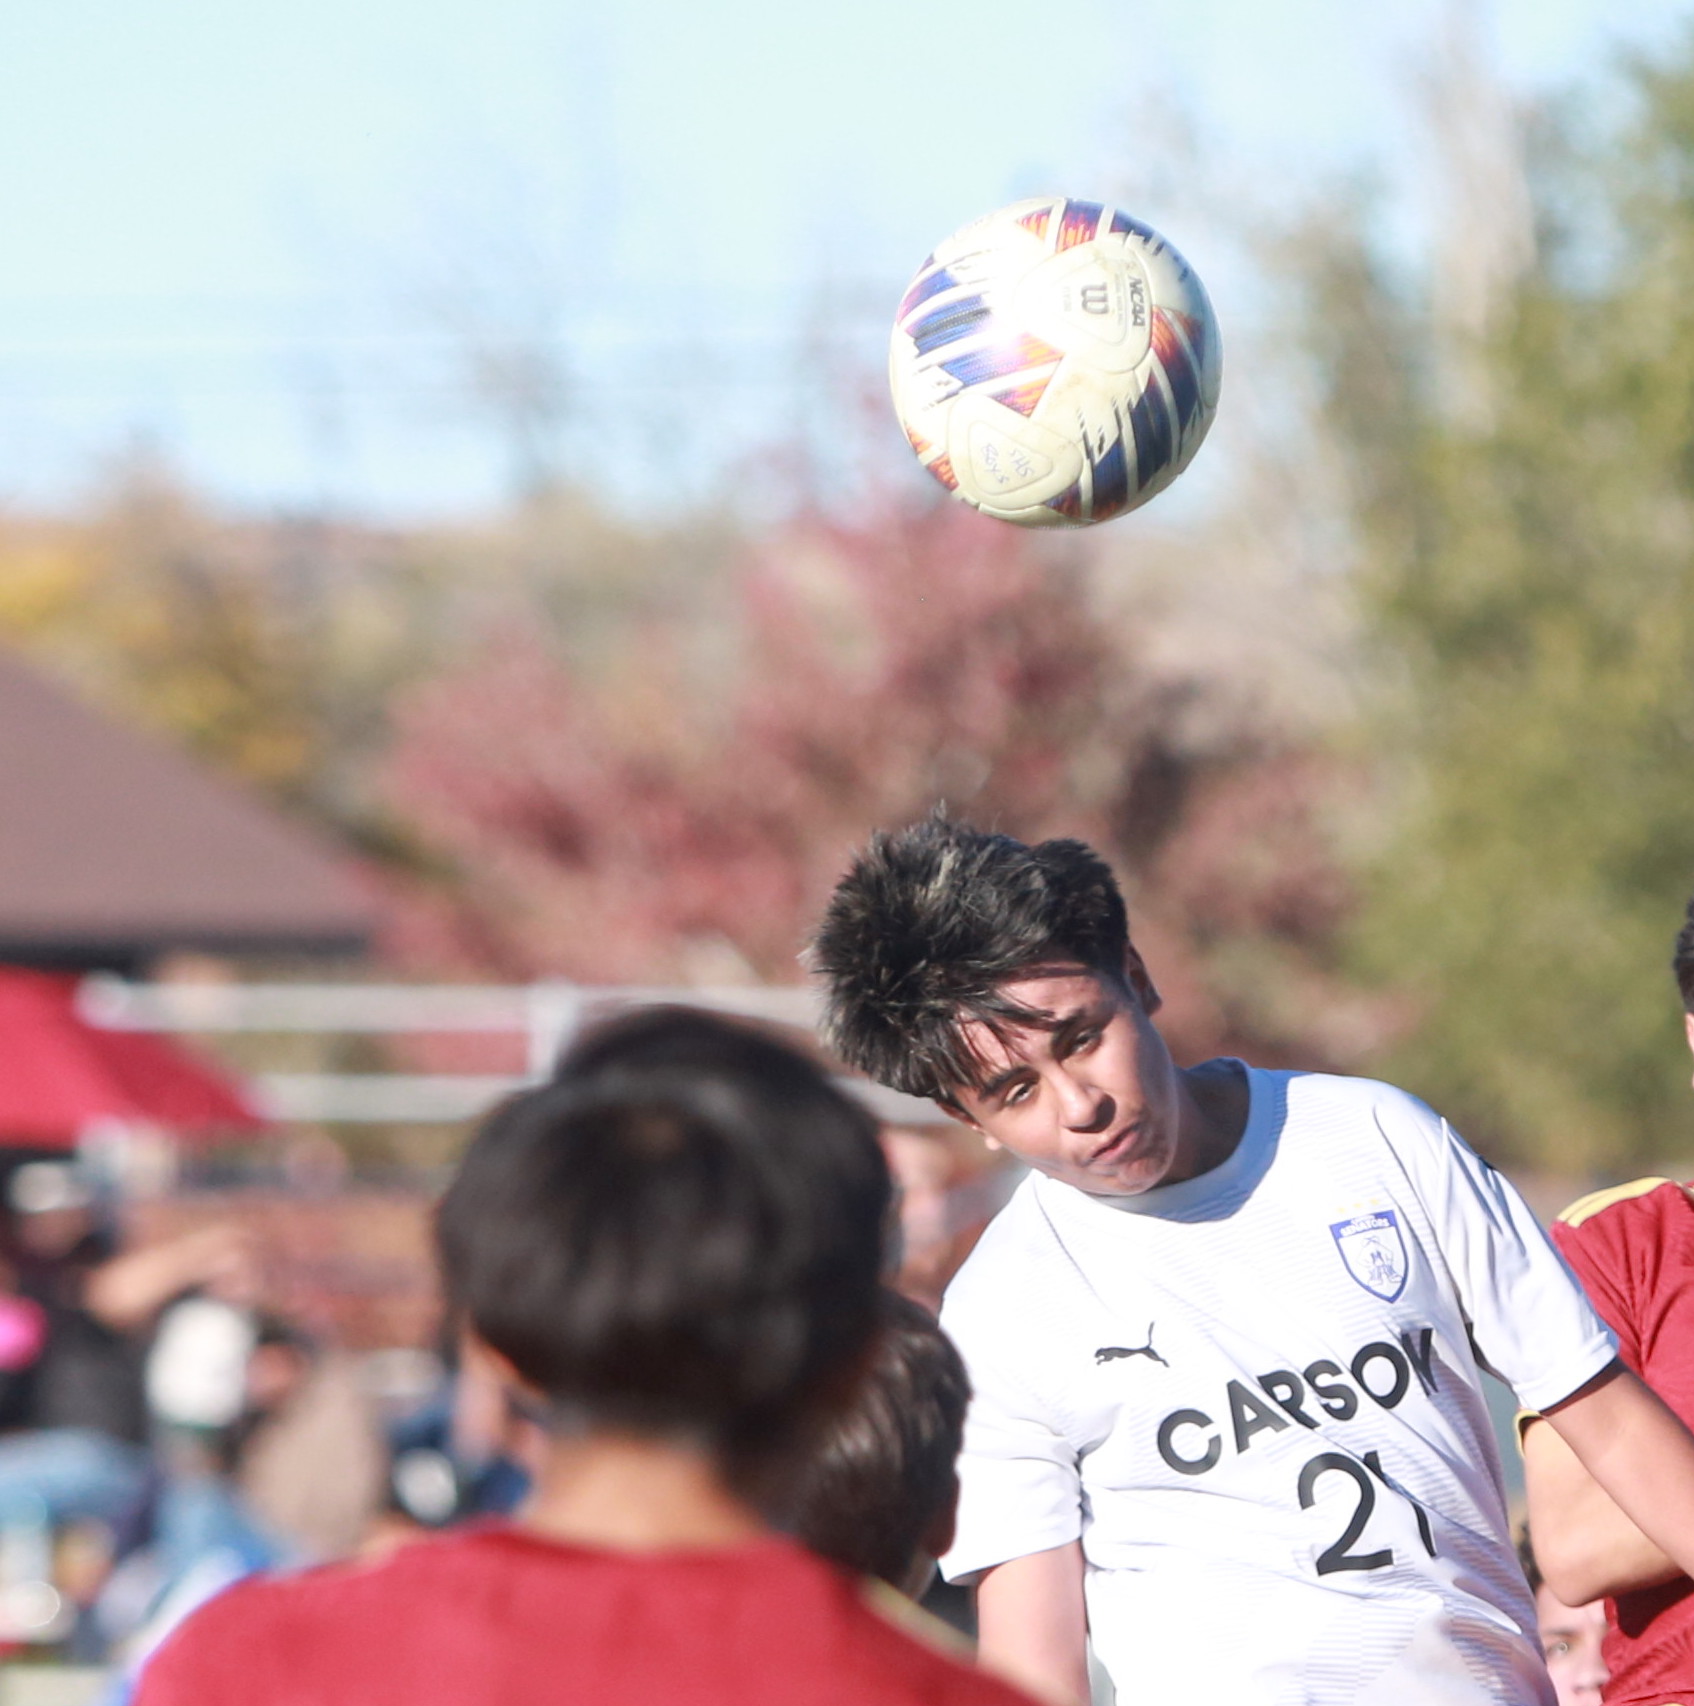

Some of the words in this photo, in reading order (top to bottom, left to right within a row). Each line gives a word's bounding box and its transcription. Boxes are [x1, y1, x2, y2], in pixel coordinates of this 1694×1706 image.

[1127, 275, 1145, 327] NCAA
[1156, 1327, 1440, 1476] CARSON
[1297, 1449, 1438, 1577] 21
